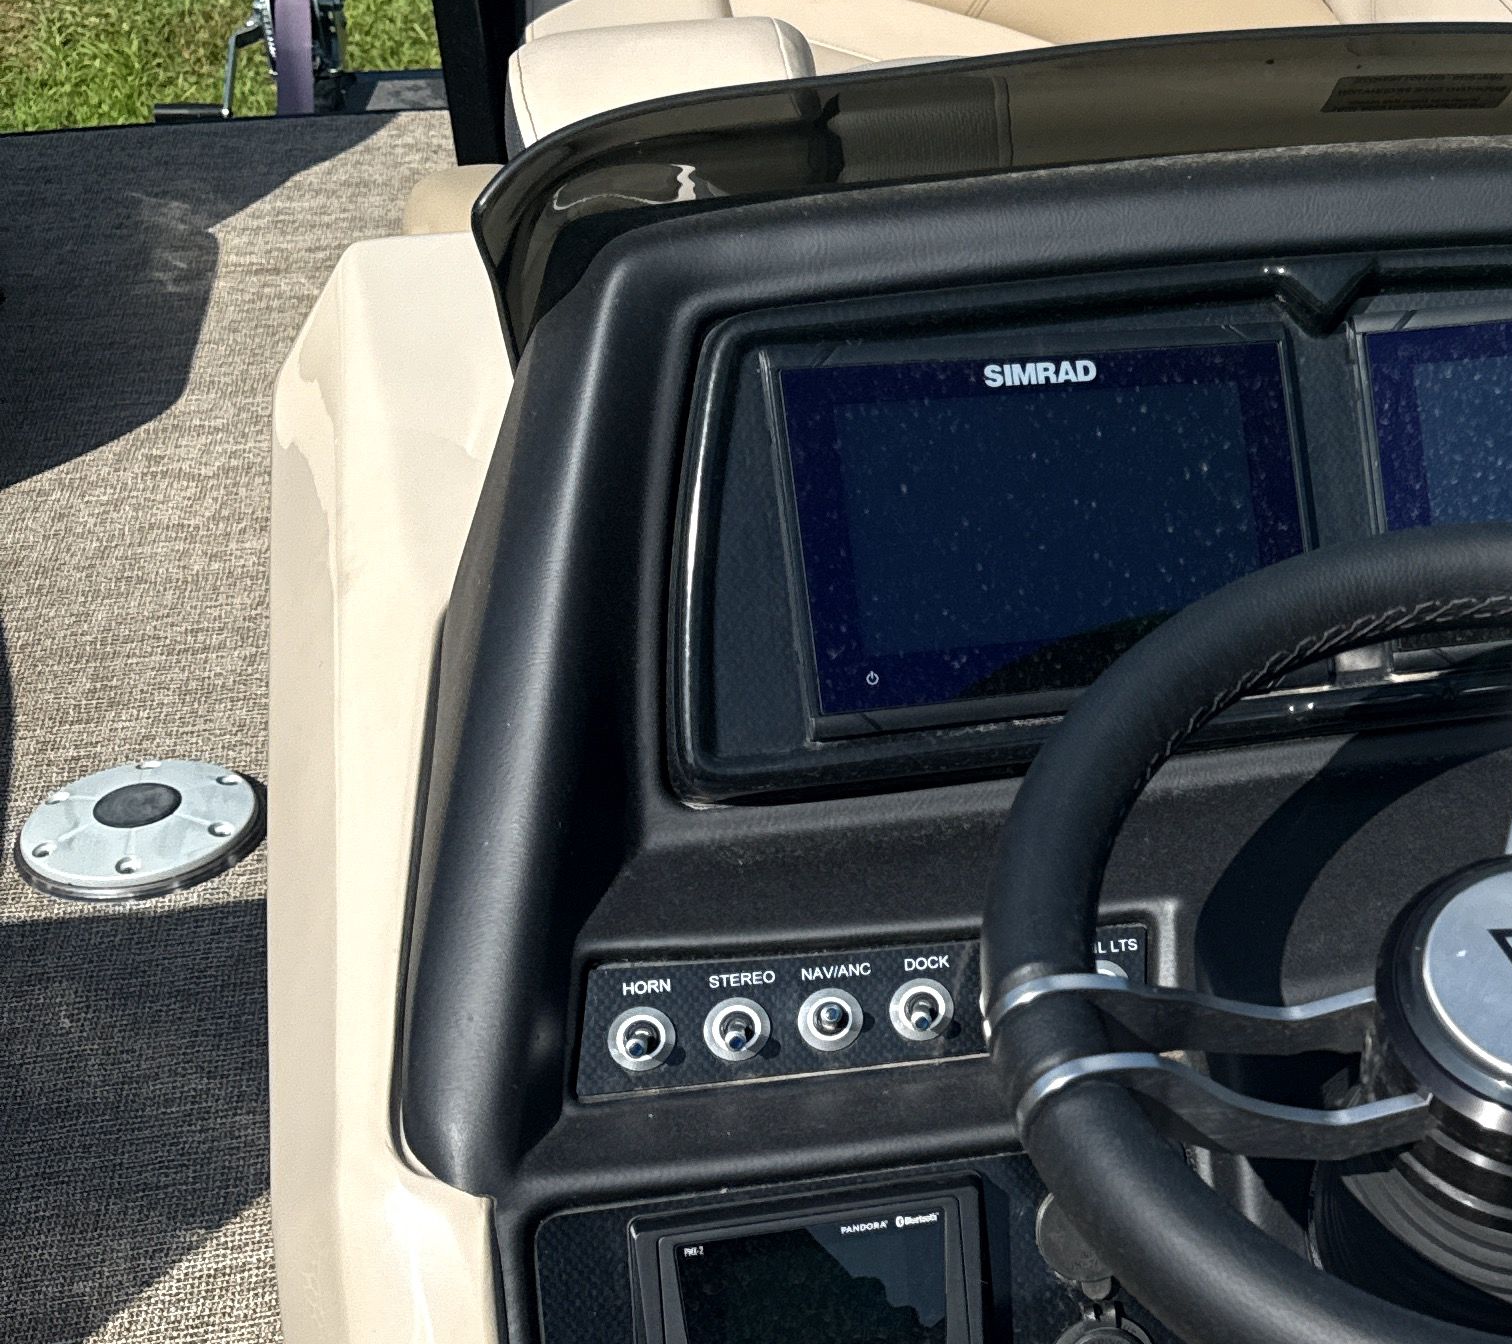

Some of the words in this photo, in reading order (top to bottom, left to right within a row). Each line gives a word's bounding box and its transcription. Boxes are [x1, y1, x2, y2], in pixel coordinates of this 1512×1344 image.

[984, 359, 1097, 387] SIMRAD
[1110, 938, 1139, 953] LTS
[801, 962, 872, 981] NAV/ANC
[904, 955, 950, 972] DOCK
[622, 978, 672, 996] HORN
[708, 970, 776, 989] STEREO
[840, 1221, 888, 1234] PANDORA
